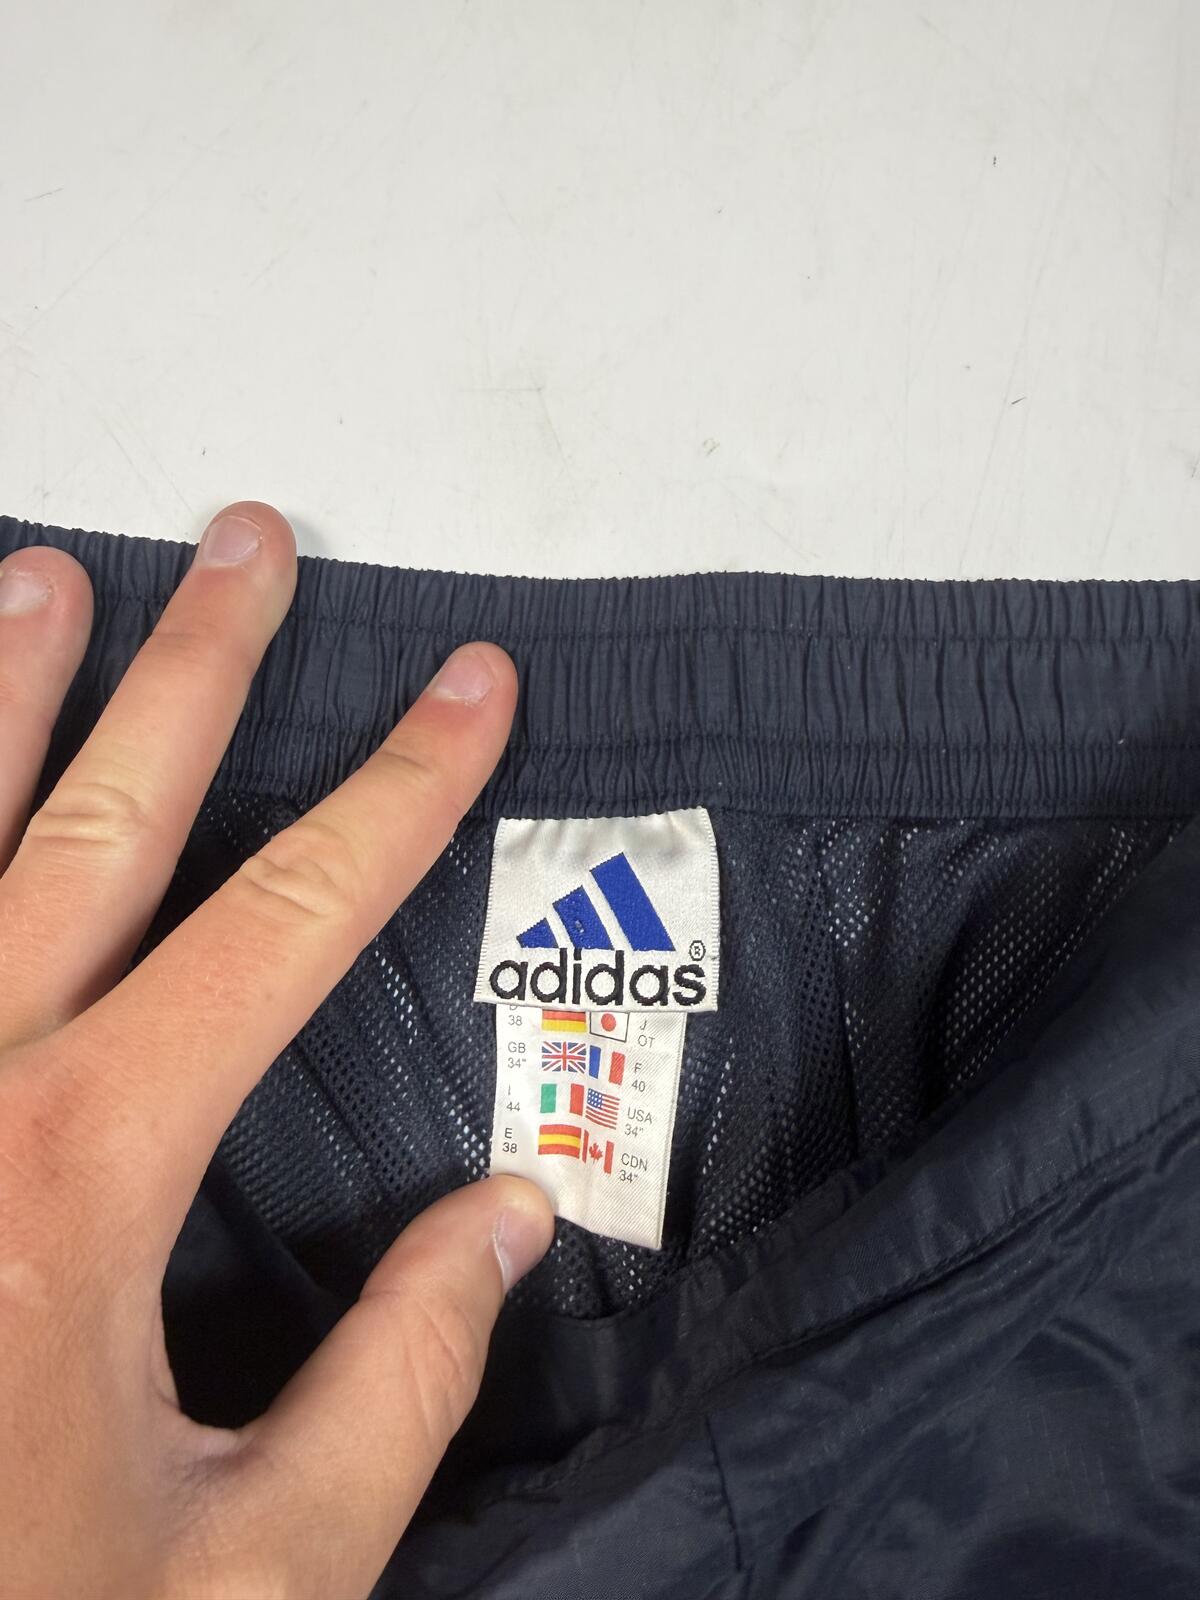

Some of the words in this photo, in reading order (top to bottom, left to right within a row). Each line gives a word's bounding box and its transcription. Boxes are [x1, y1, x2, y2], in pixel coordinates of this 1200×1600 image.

[489, 947, 706, 1006] adidas
[508, 1015, 522, 1026] 38
[639, 1020, 648, 1031] J
[507, 1041, 526, 1053] GB
[637, 1035, 655, 1048] OT
[507, 1057, 526, 1069] 34"
[634, 1063, 642, 1073] F
[631, 1081, 646, 1092] 40
[506, 1101, 521, 1112] 44
[627, 1107, 653, 1124] USA
[504, 1127, 512, 1139] E
[624, 1123, 644, 1137] 34"
[502, 1143, 517, 1154] 38
[621, 1153, 648, 1172] CDN
[619, 1169, 639, 1183] 34"
